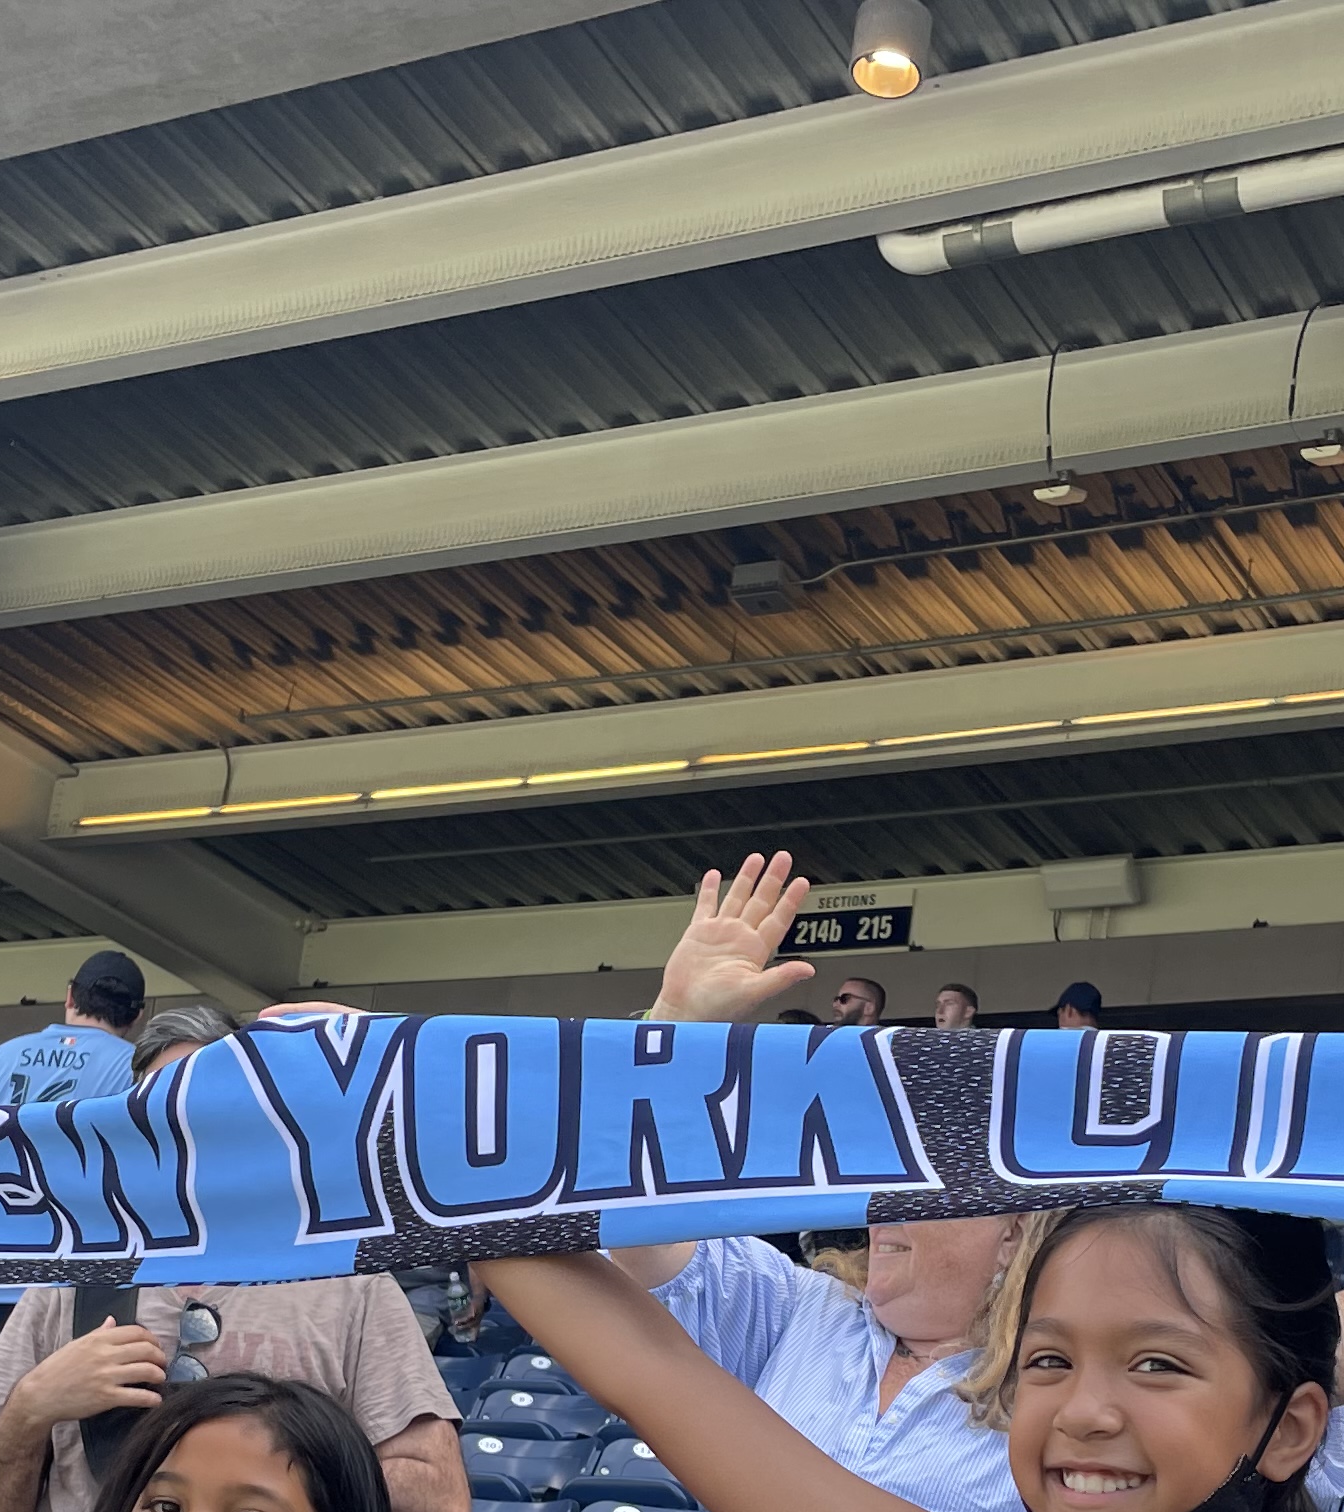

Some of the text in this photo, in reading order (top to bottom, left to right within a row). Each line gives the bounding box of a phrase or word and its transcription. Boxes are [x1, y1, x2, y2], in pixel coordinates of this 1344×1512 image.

[817, 893, 877, 909] SECTIONS
[794, 914, 893, 945] 214b 215
[19, 1047, 91, 1070] SANDS
[233, 1013, 944, 1245] YORK
